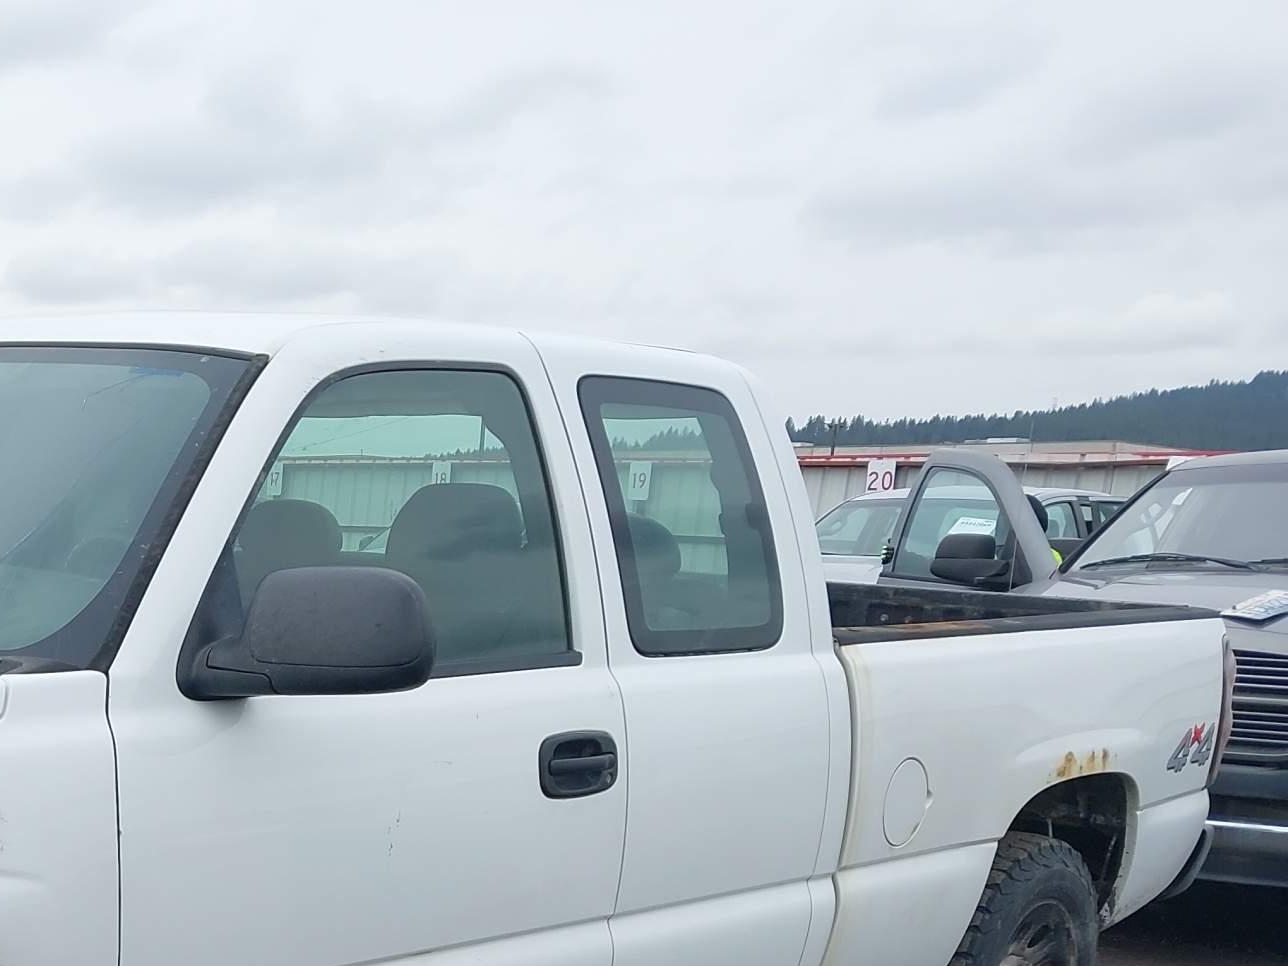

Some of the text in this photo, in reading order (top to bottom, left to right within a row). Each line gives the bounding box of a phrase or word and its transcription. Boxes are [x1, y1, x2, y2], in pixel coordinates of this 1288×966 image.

[270, 471, 280, 487] 17
[632, 472, 647, 489] 19
[867, 471, 893, 491] 20
